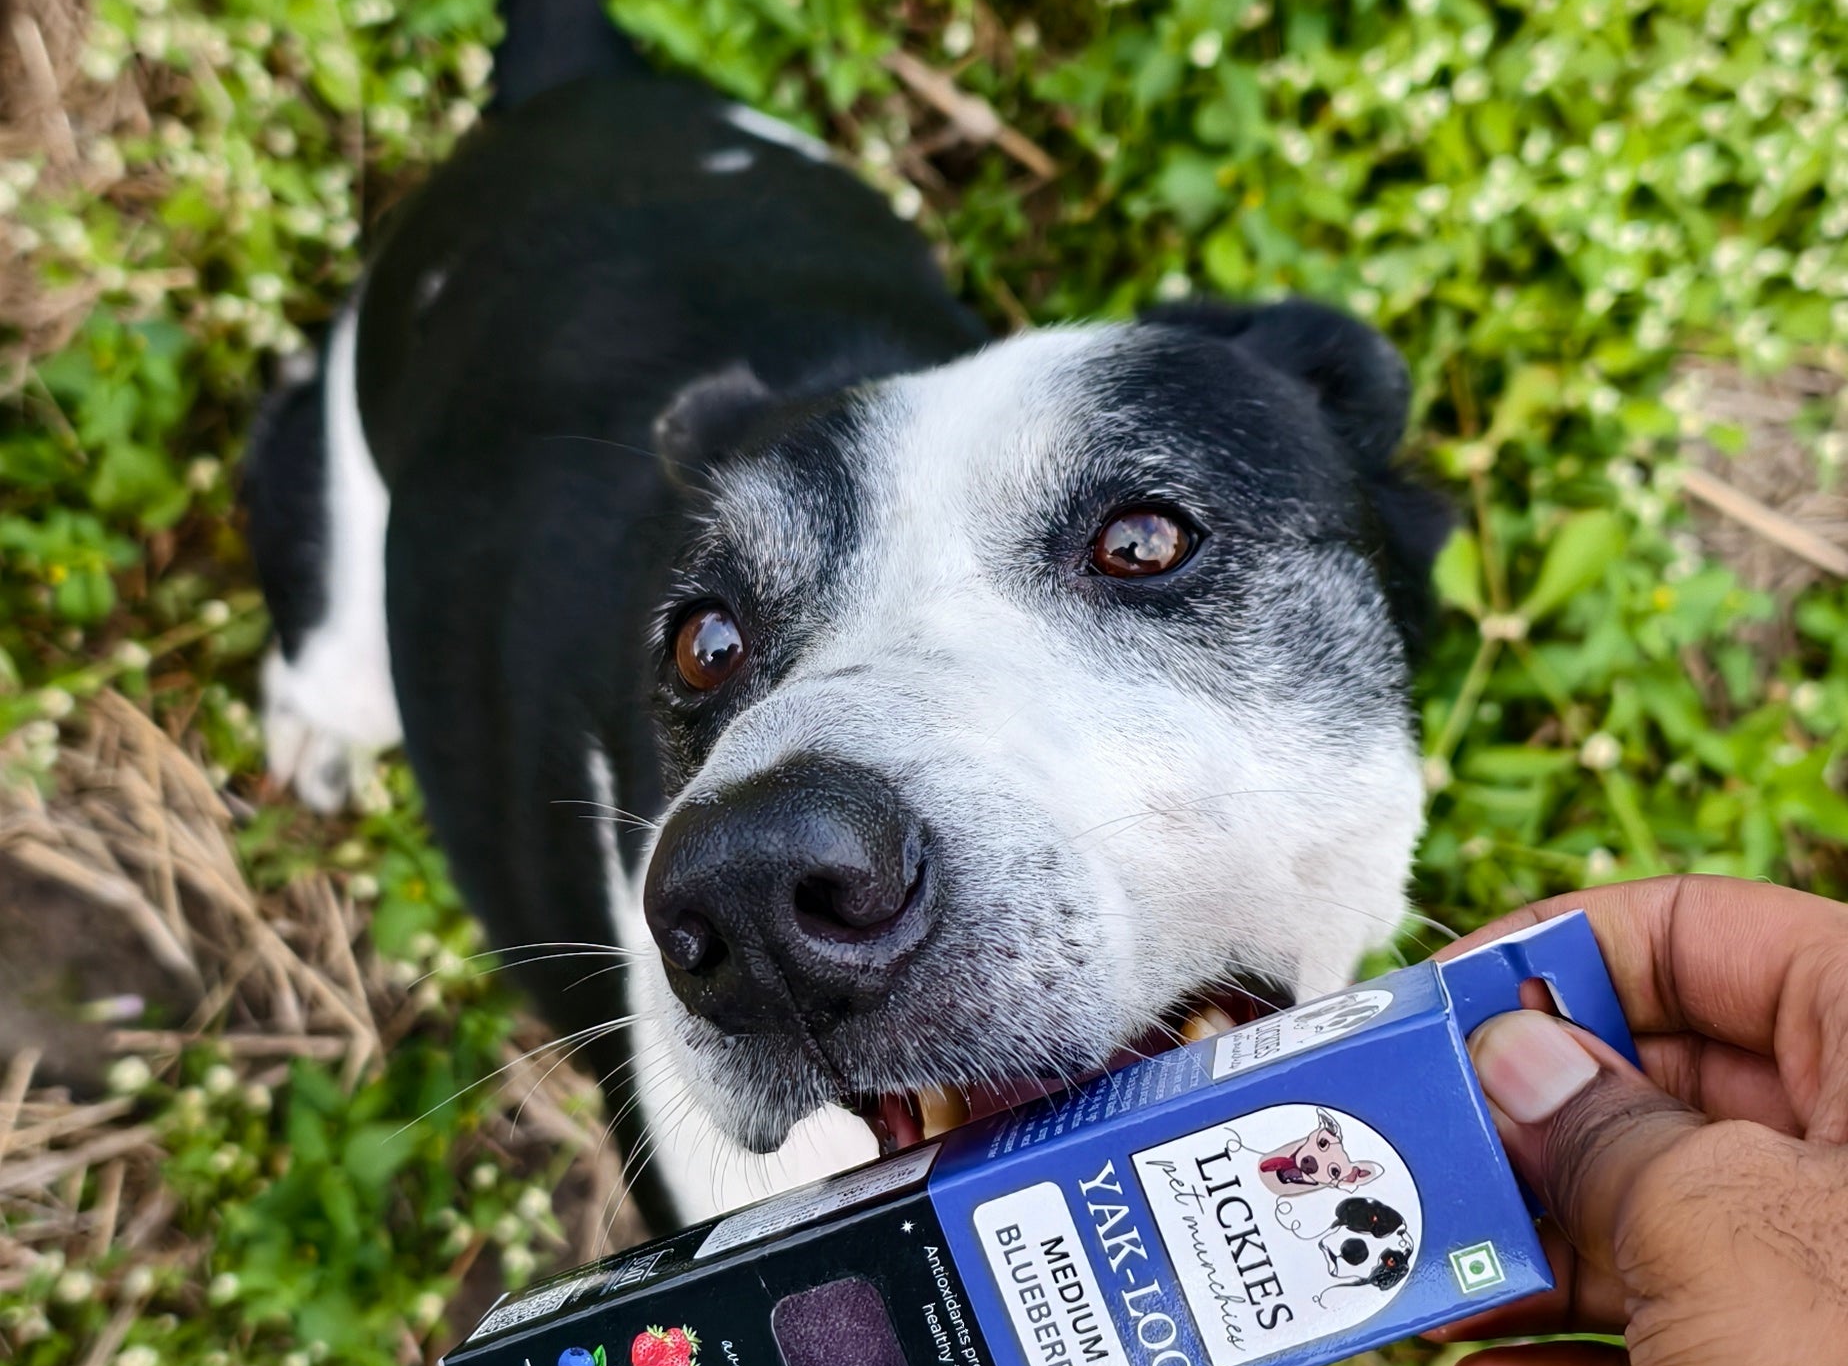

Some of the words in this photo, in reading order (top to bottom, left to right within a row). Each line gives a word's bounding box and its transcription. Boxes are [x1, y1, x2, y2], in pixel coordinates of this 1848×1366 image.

[924, 1247, 970, 1345] Antioxidants
[1041, 1236, 1108, 1362] MEDIUM
[1146, 1161, 1205, 1221] pet
[1182, 1209, 1246, 1351] munchies
[1195, 1146, 1293, 1330] LICKIES
[923, 1303, 954, 1361] healthy
